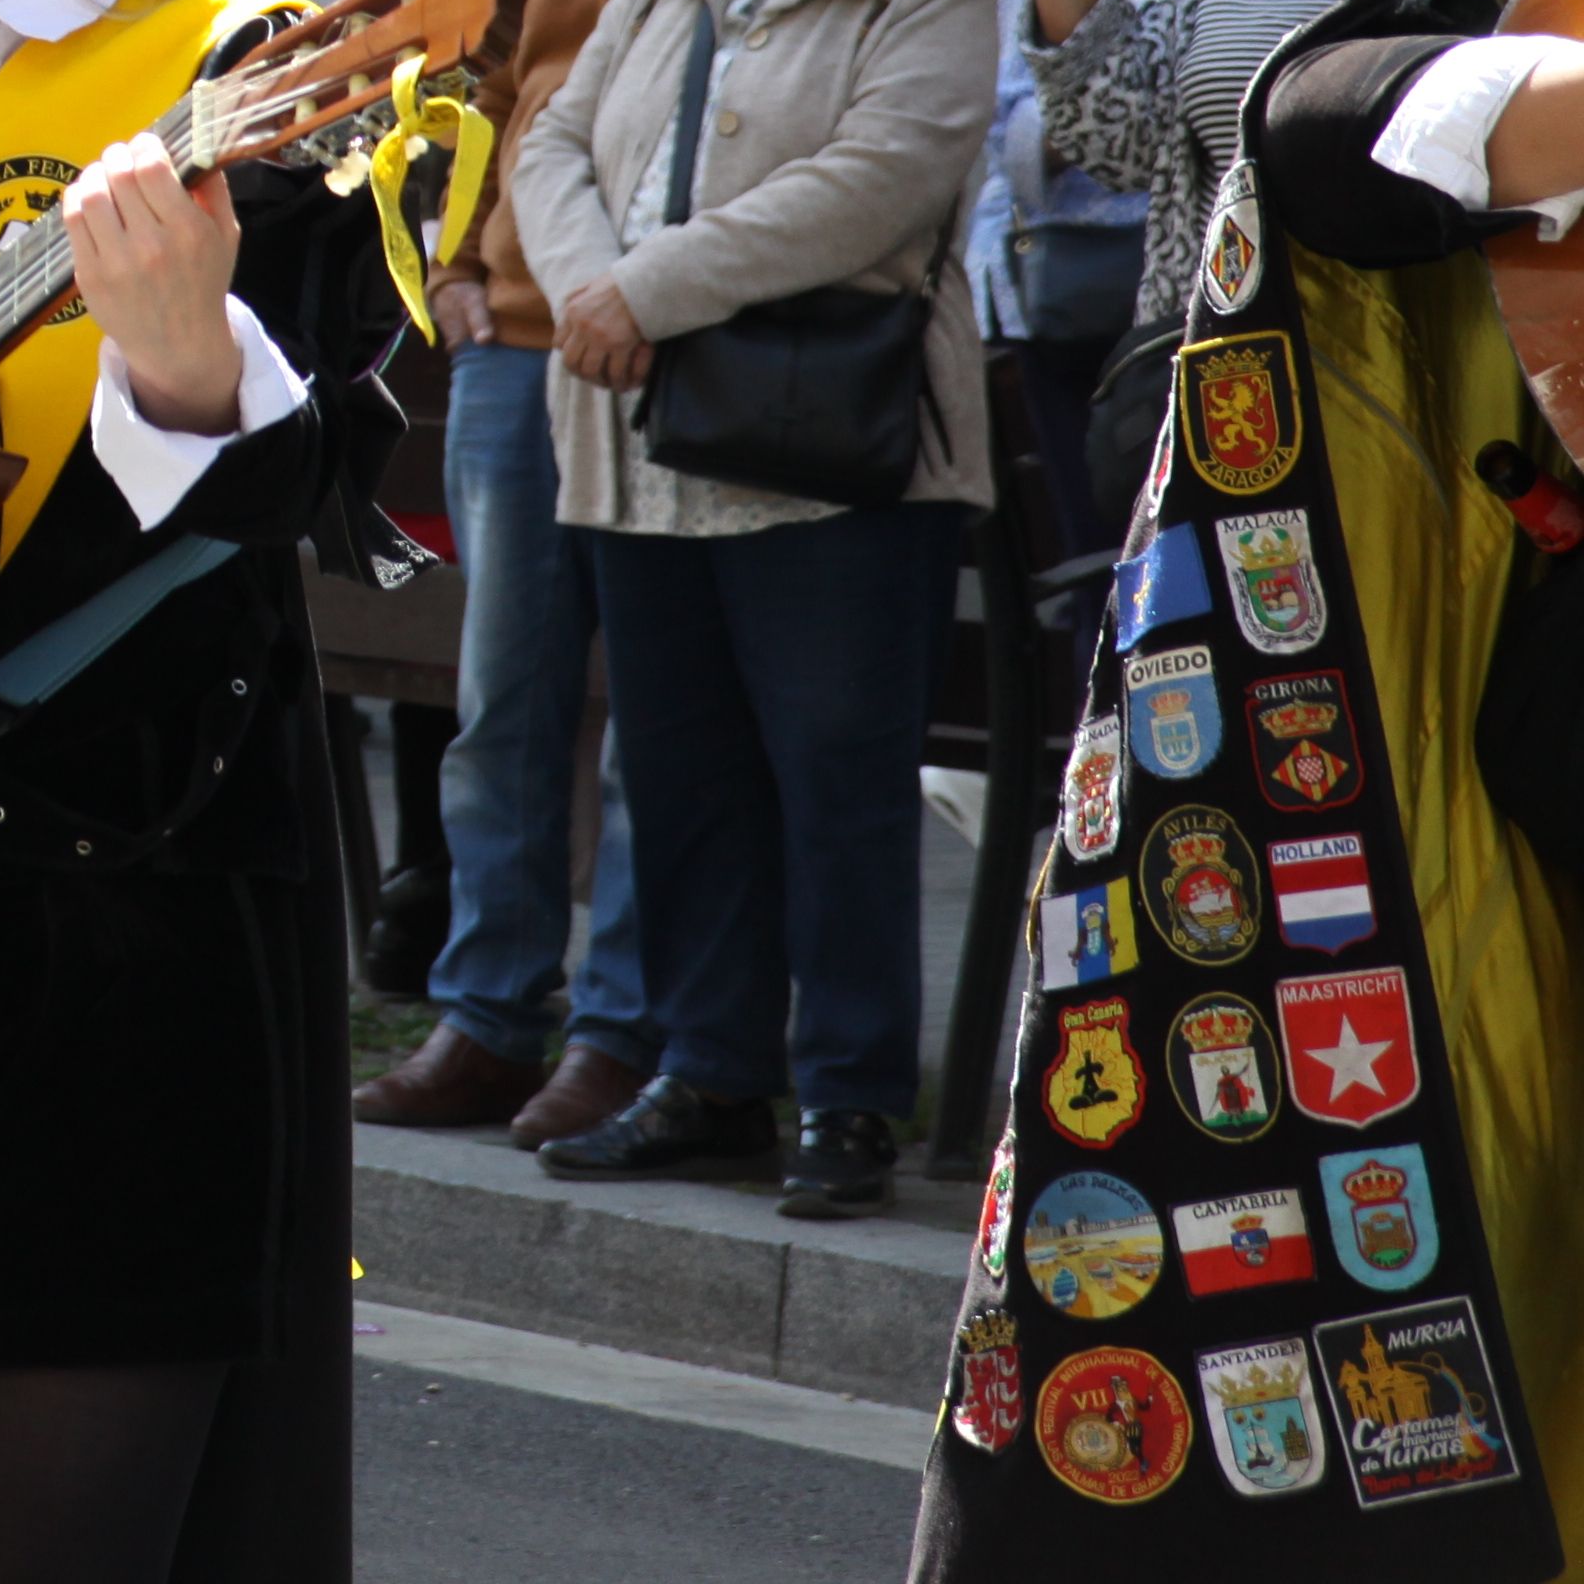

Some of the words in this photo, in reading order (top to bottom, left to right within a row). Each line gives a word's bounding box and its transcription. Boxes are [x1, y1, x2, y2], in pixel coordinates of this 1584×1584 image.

[1200, 446, 1295, 489] ZARAGOZA
[1131, 651, 1209, 684] OVIEDO
[1254, 677, 1333, 701] GIRONA
[1163, 815, 1228, 840] AVILÉS
[1272, 837, 1358, 863] HOLLAND
[1281, 975, 1400, 1004] MAASTRICHT
[1060, 1176, 1086, 1192] LAS
[1090, 1175, 1144, 1212] PALMAS
[1192, 1190, 1289, 1220] CANTABRIA
[1387, 1318, 1467, 1352] MURCIA
[1198, 1340, 1304, 1372] SANTANDER
[1042, 1385, 1064, 1436] FESTIVAL
[1059, 1352, 1142, 1385] INTERNACIONAL
[1070, 1387, 1110, 1411] VII
[1360, 1457, 1380, 1474] de
[1382, 1438, 1466, 1469] Tunas
[1063, 1462, 1107, 1495] PALMAS
[1110, 1484, 1127, 1498] DE
